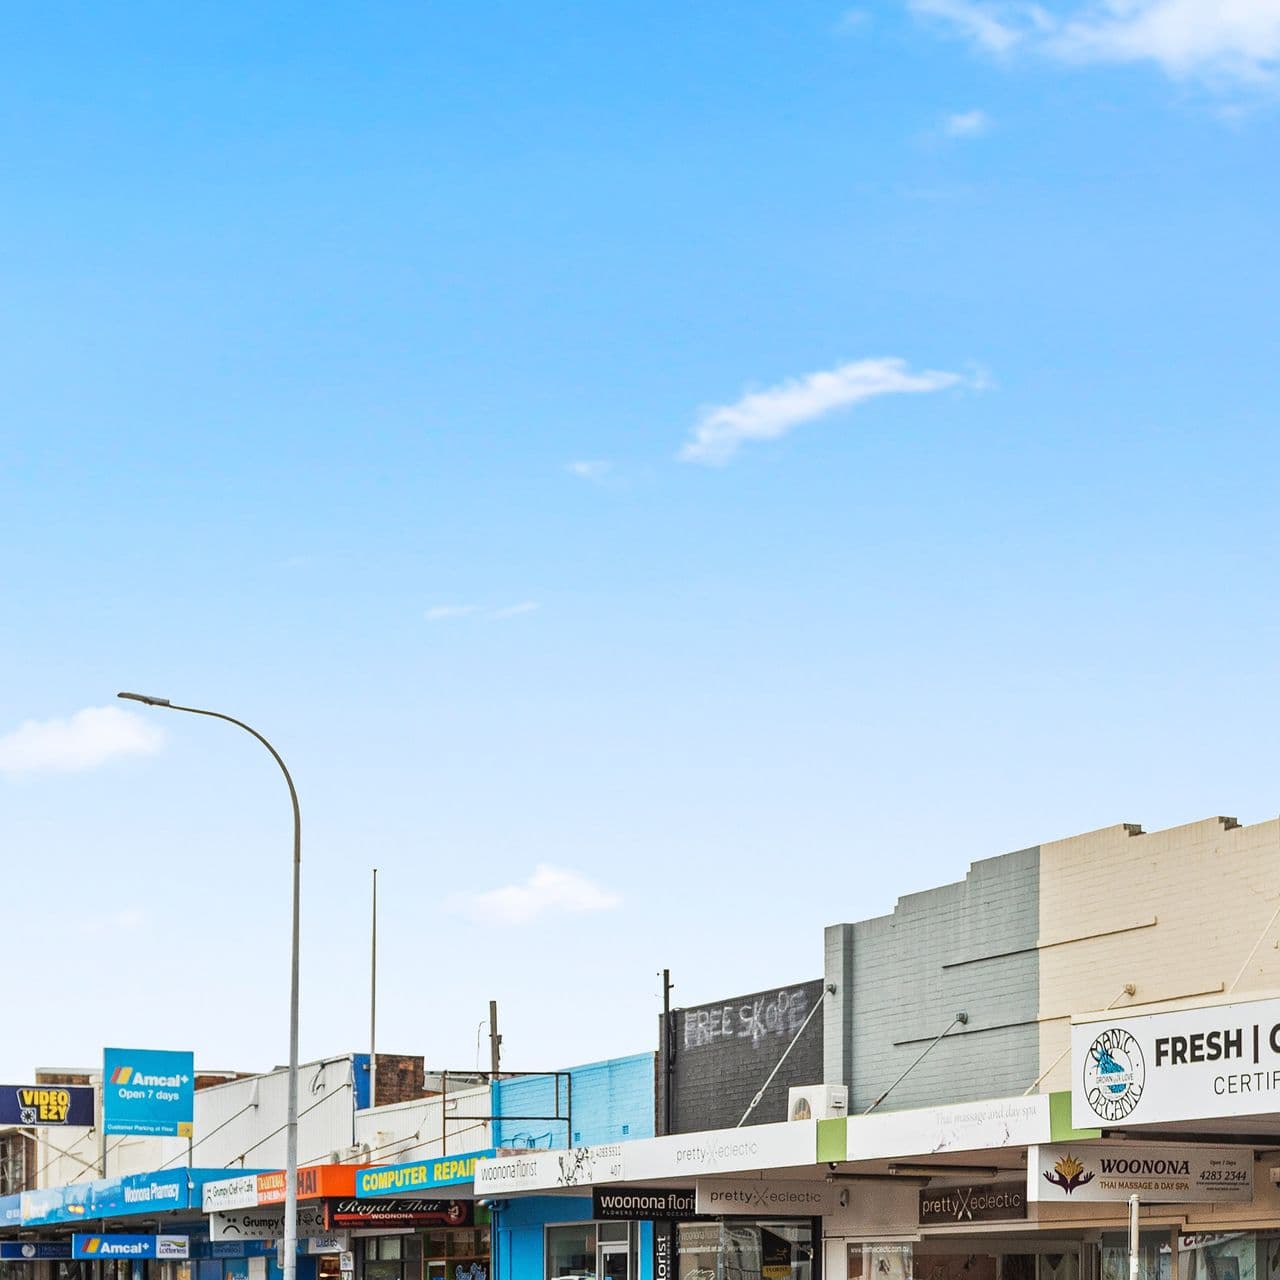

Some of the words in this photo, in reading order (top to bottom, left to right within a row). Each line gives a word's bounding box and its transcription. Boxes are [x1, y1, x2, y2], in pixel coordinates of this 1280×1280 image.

[684, 1007, 733, 1051] FREE
[1154, 1028, 1243, 1067] FRESH
[23, 1089, 68, 1105] VIDEO
[118, 1088, 145, 1099] Open
[147, 1089, 154, 1099] 7
[155, 1090, 180, 1101] days
[1088, 1083, 1143, 1120] ORGANIC
[39, 1104, 68, 1120] EZY
[676, 1147, 705, 1164] pretty
[718, 1141, 758, 1159] eclectic
[362, 1163, 427, 1191] COMPUTER
[433, 1156, 487, 1181] REPAI
[1100, 1159, 1191, 1175] WOONONA
[296, 1170, 317, 1195] HAI
[1199, 1170, 1222, 1181] 4283
[1224, 1170, 1247, 1181] 2344
[124, 1186, 150, 1203] Woonona
[150, 1182, 179, 1201] Pharmacy
[1100, 1182, 1117, 1190] THAI
[1118, 1182, 1153, 1190] MASSAGE
[1160, 1182, 1174, 1190] DAY
[1175, 1182, 1190, 1190] SPA
[601, 1195, 666, 1210] woonona
[668, 1194, 697, 1210] flori
[710, 1190, 753, 1204] pretty
[769, 1191, 822, 1202] eclectic
[922, 1196, 959, 1216] pretty
[970, 1193, 1021, 1211] eclectic
[336, 1200, 397, 1215] Royal
[398, 1199, 441, 1212] Thai
[243, 1215, 279, 1229] Grumpy
